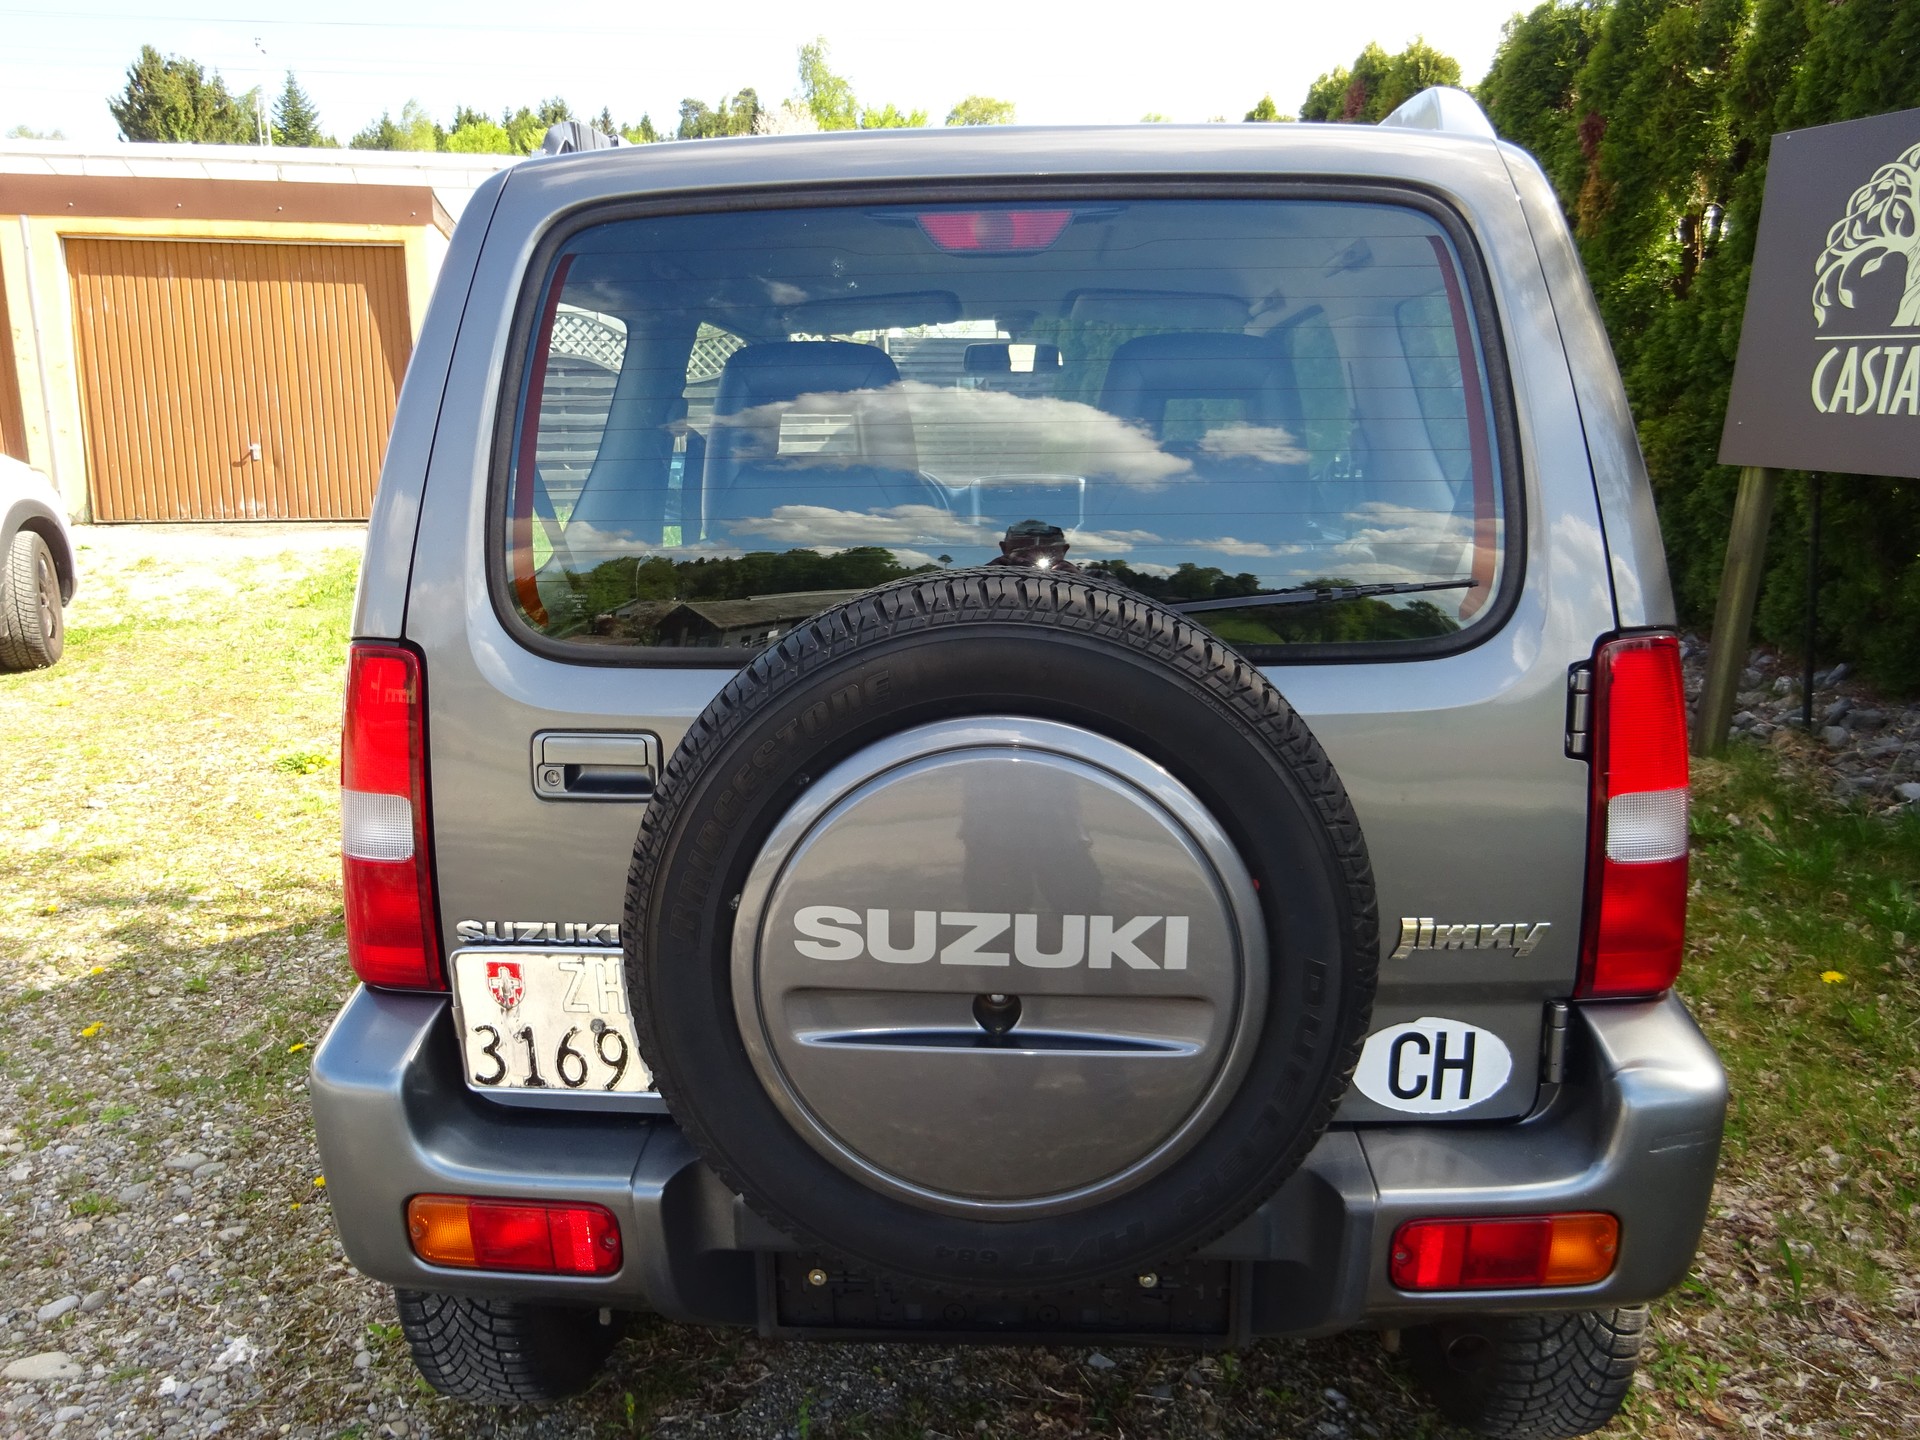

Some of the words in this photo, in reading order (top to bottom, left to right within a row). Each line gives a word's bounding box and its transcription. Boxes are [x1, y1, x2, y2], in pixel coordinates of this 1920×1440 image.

[1811, 345, 1920, 415] CASTA
[669, 669, 891, 941] BRIDGESTONE
[456, 919, 621, 945] SUZUKI
[792, 905, 1189, 969] SUZUKI
[558, 957, 627, 1013] ZH
[471, 1024, 661, 1092] 3169
[1388, 1031, 1475, 1100] CH
